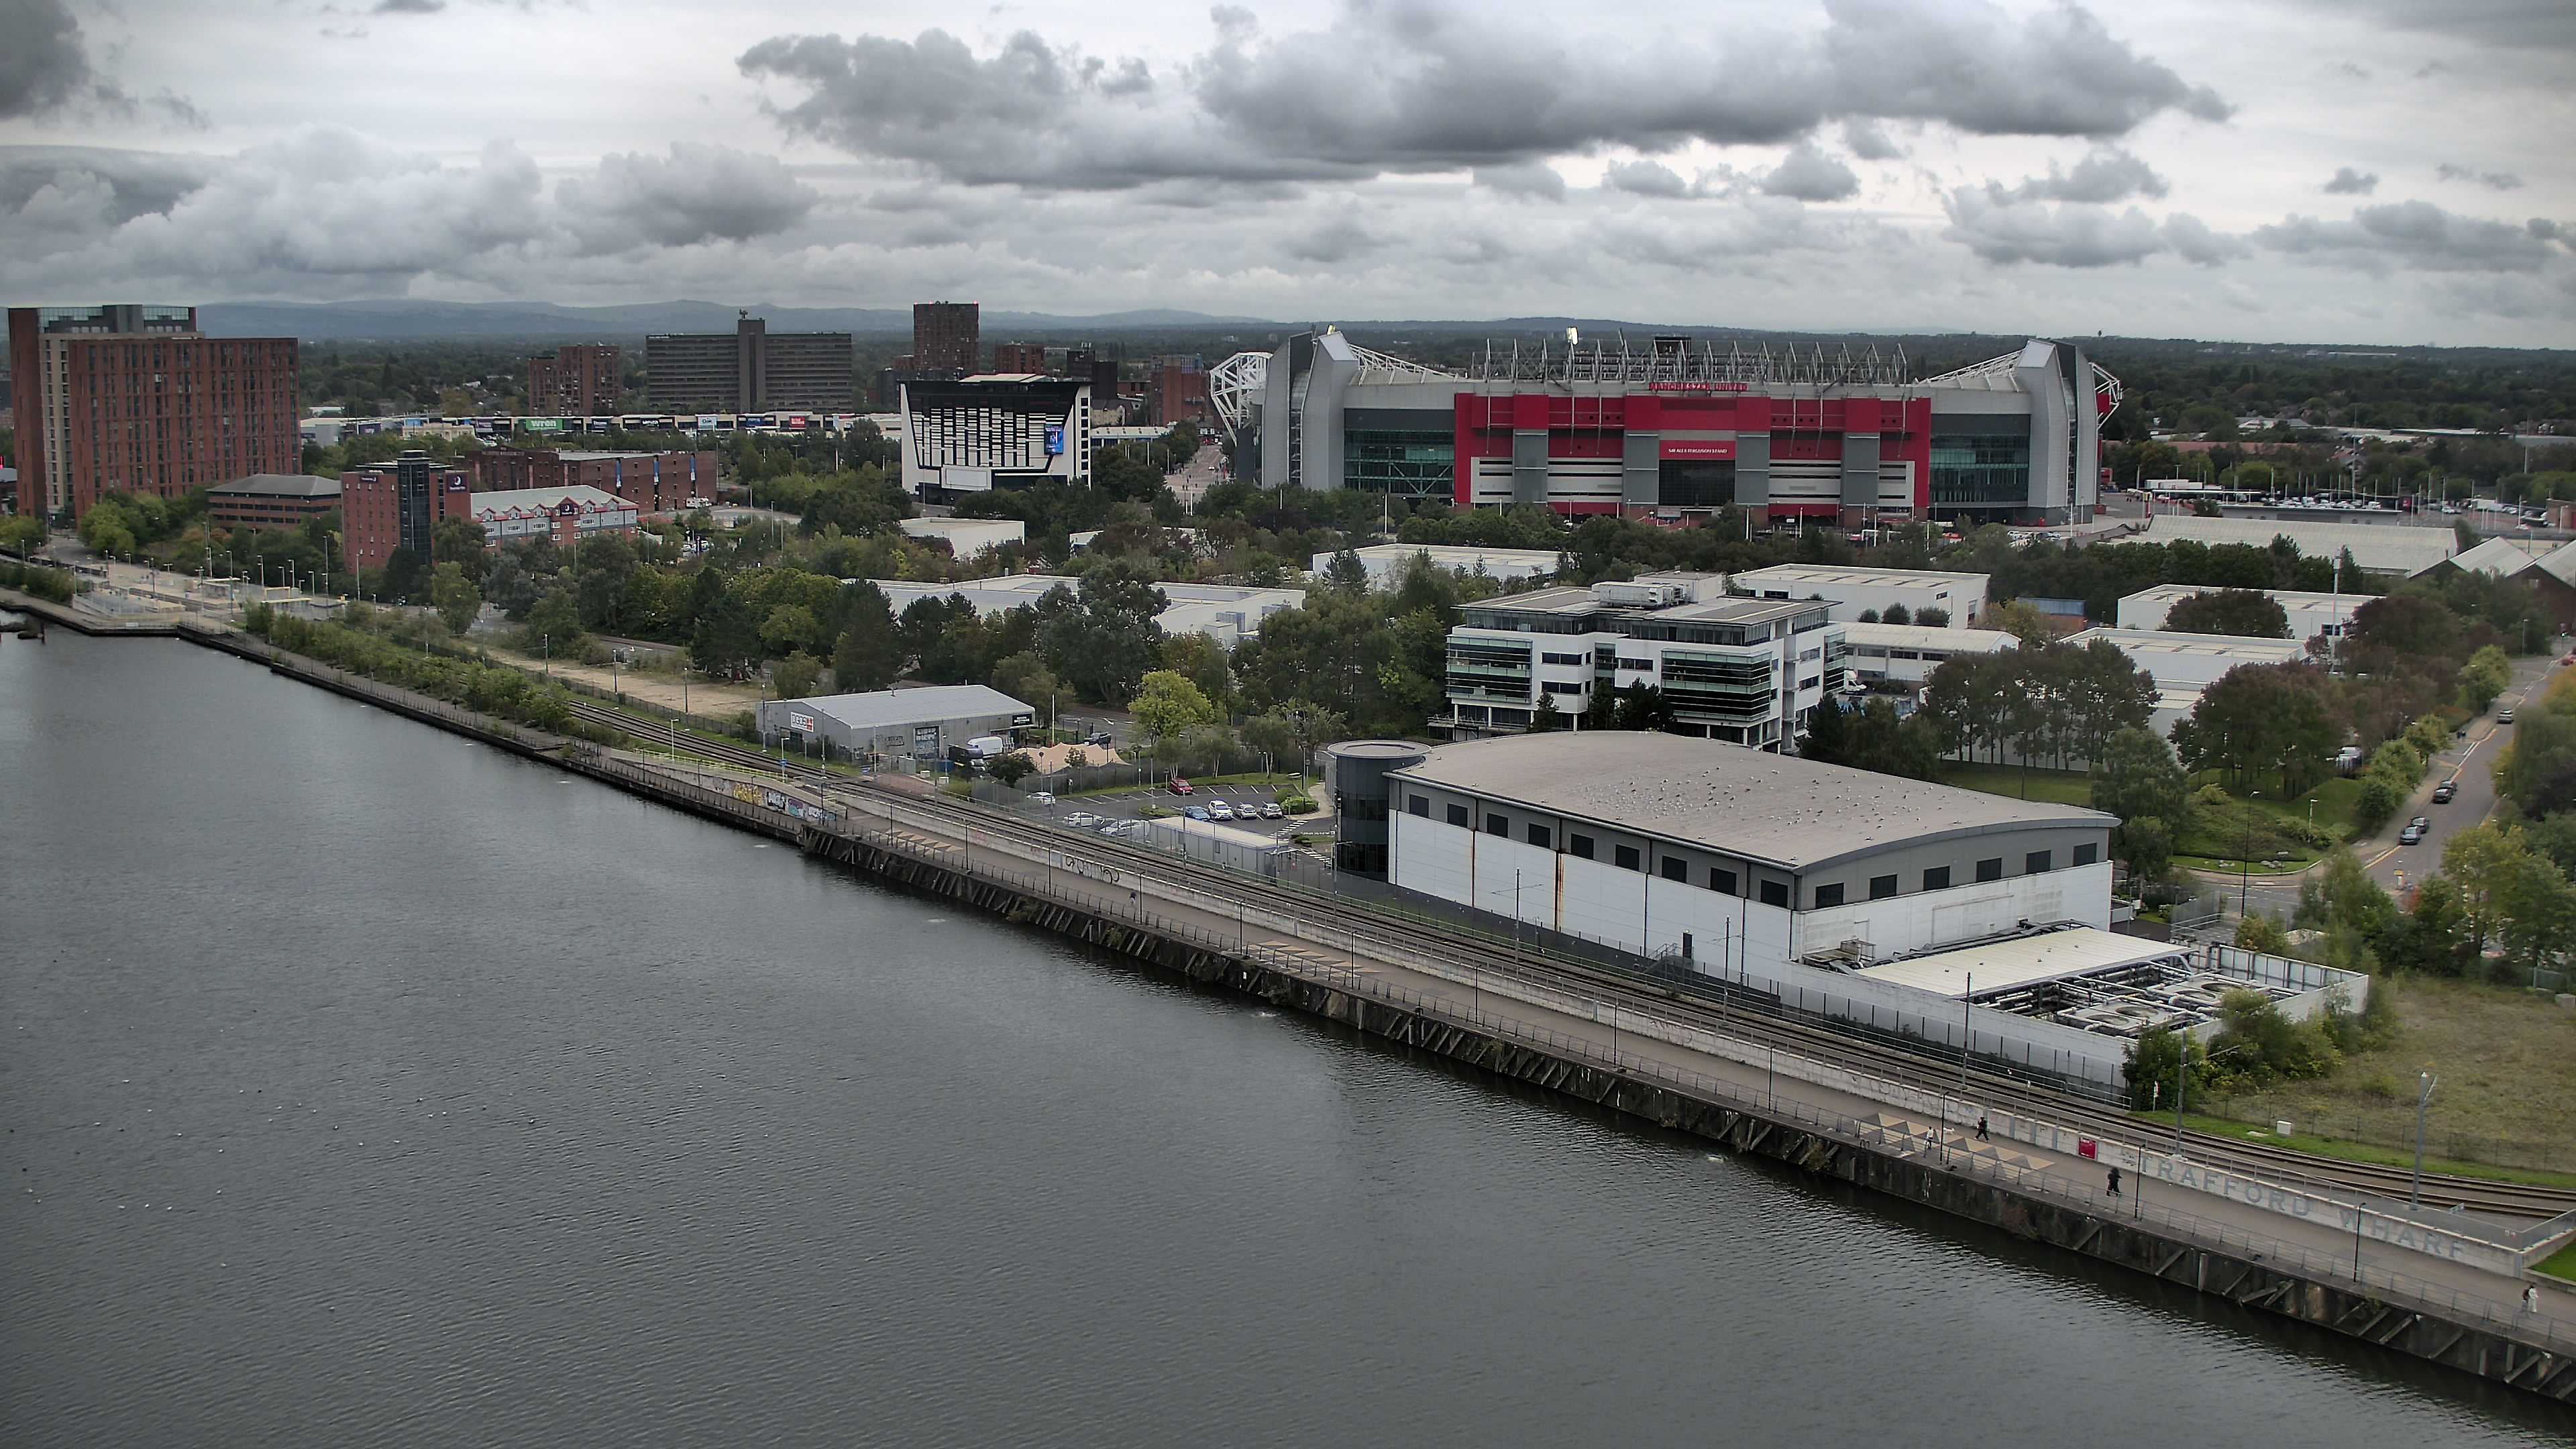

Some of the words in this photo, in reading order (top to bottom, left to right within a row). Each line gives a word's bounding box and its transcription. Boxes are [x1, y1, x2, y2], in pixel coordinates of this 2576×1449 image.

[531, 419, 557, 427] wren
[2141, 1155, 2310, 1217] TRAFFORD
[2339, 1207, 2467, 1258] WHARF
